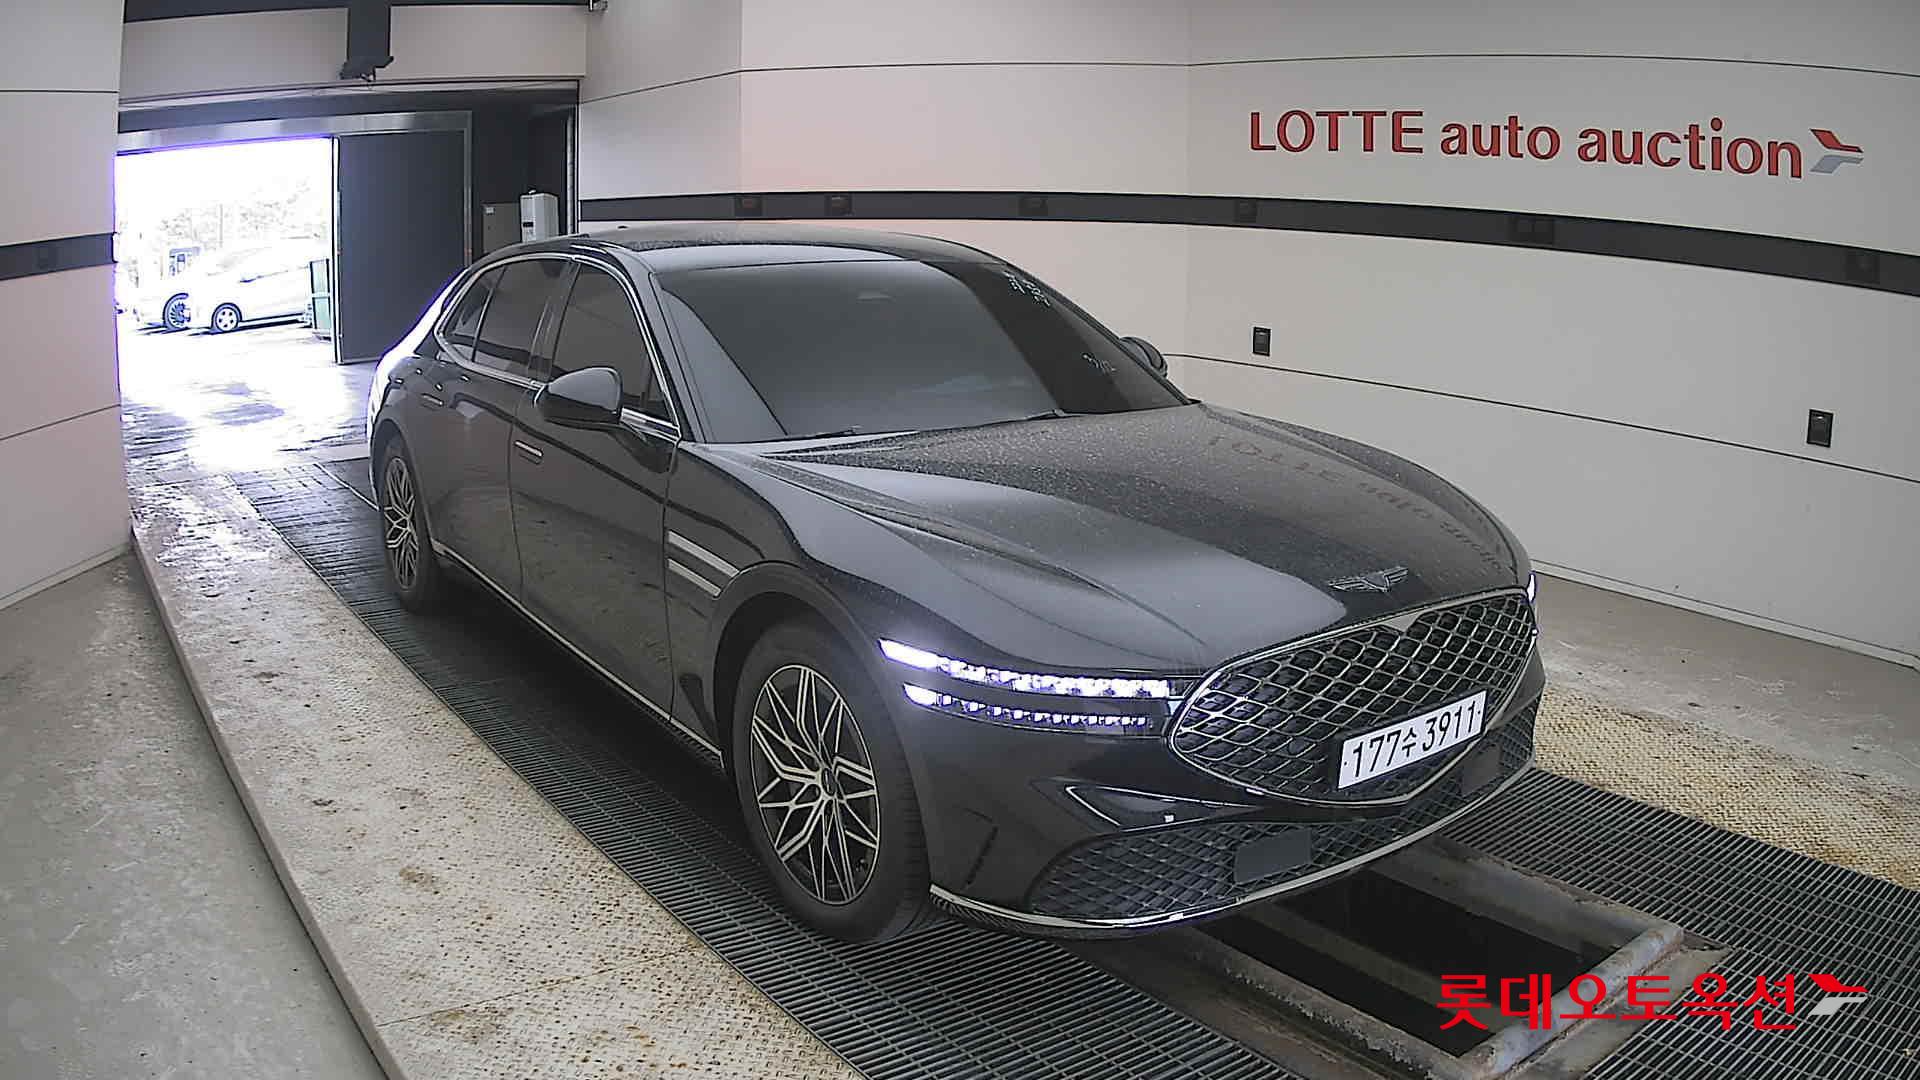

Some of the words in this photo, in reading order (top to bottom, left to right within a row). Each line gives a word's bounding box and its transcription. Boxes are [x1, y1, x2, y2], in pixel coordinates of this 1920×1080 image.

[1249, 110, 1424, 153] LOTTE
[1440, 115, 1561, 160] auto
[1577, 117, 1803, 178] auction
